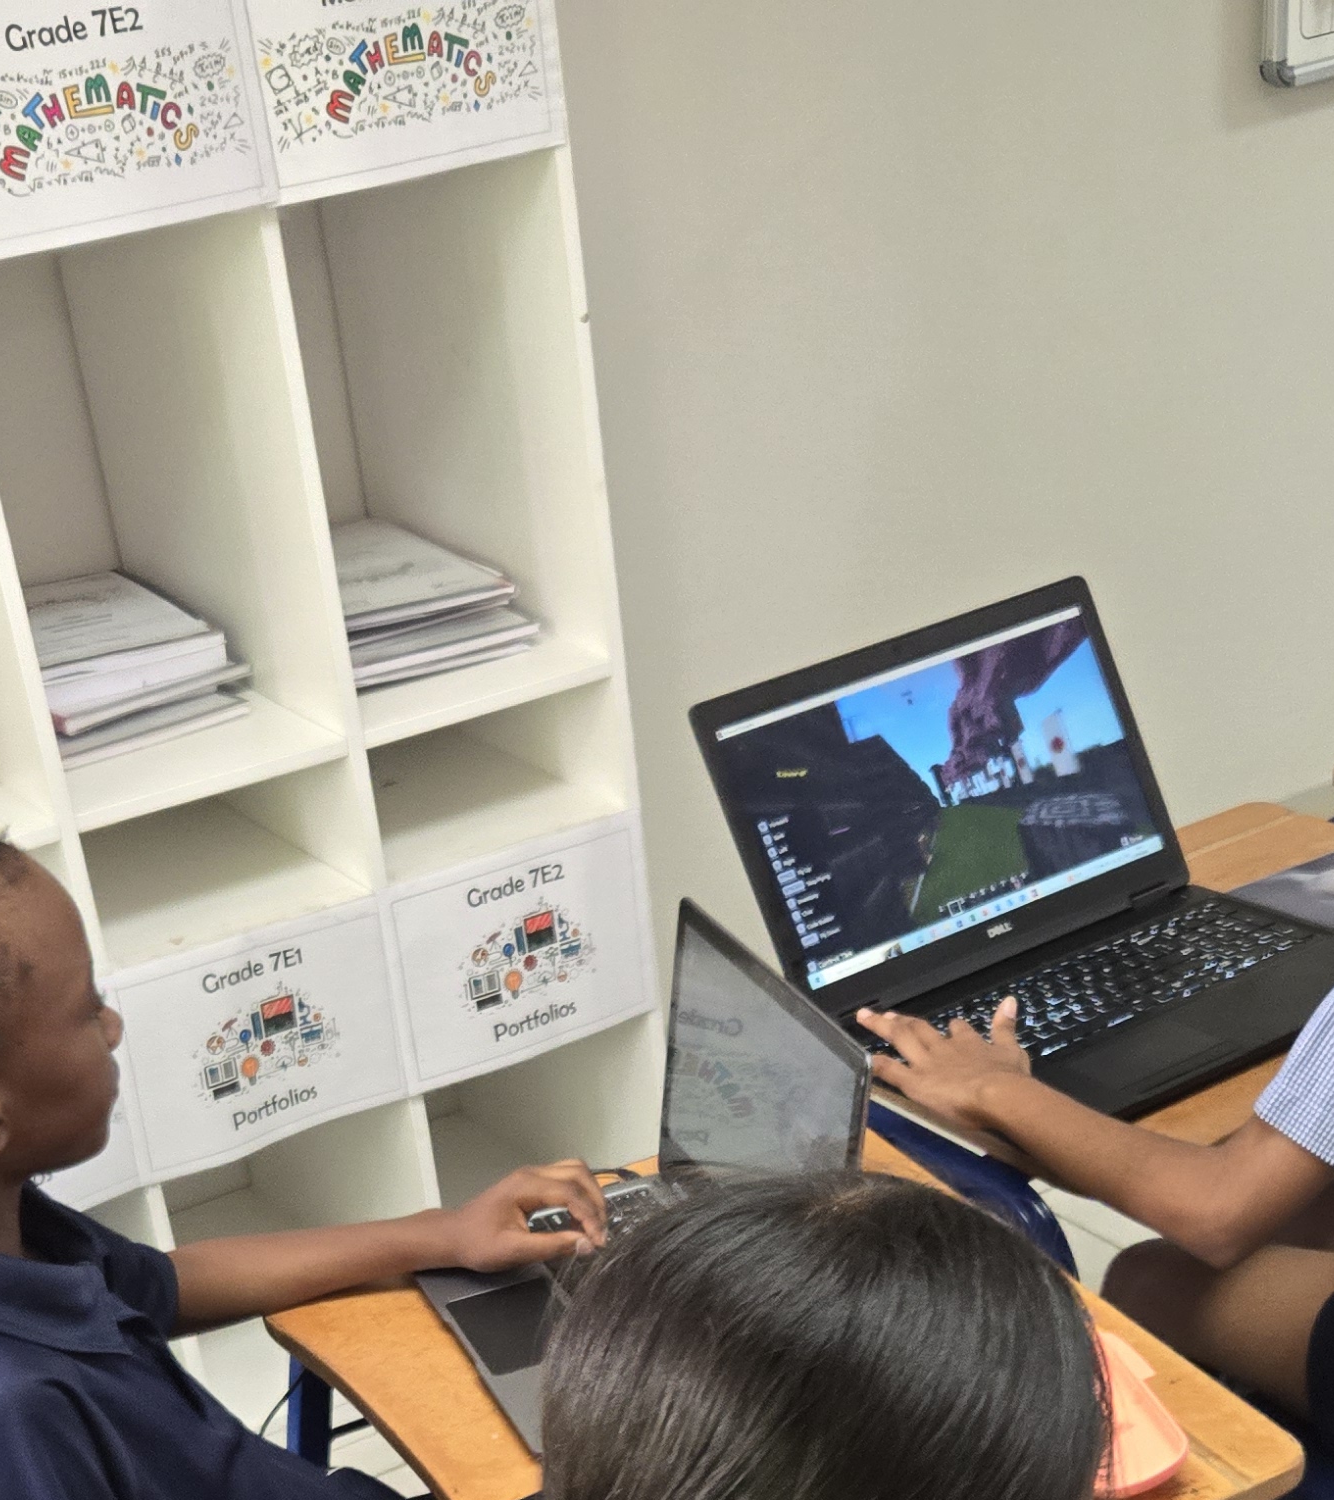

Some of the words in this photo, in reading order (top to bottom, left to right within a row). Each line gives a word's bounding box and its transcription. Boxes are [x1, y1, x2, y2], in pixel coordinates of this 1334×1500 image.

[5, 16, 88, 51] Grade
[92, 6, 144, 36] 7E2
[326, 22, 497, 124] MATHEMATICS
[0, 74, 200, 181] MATHEMATICS
[467, 875, 525, 909] Grade
[528, 863, 566, 889] 7E2
[202, 960, 264, 994] Grade
[268, 947, 304, 973] 7E1
[492, 998, 578, 1042] Portfolios
[233, 1083, 319, 1131] Portfolios
